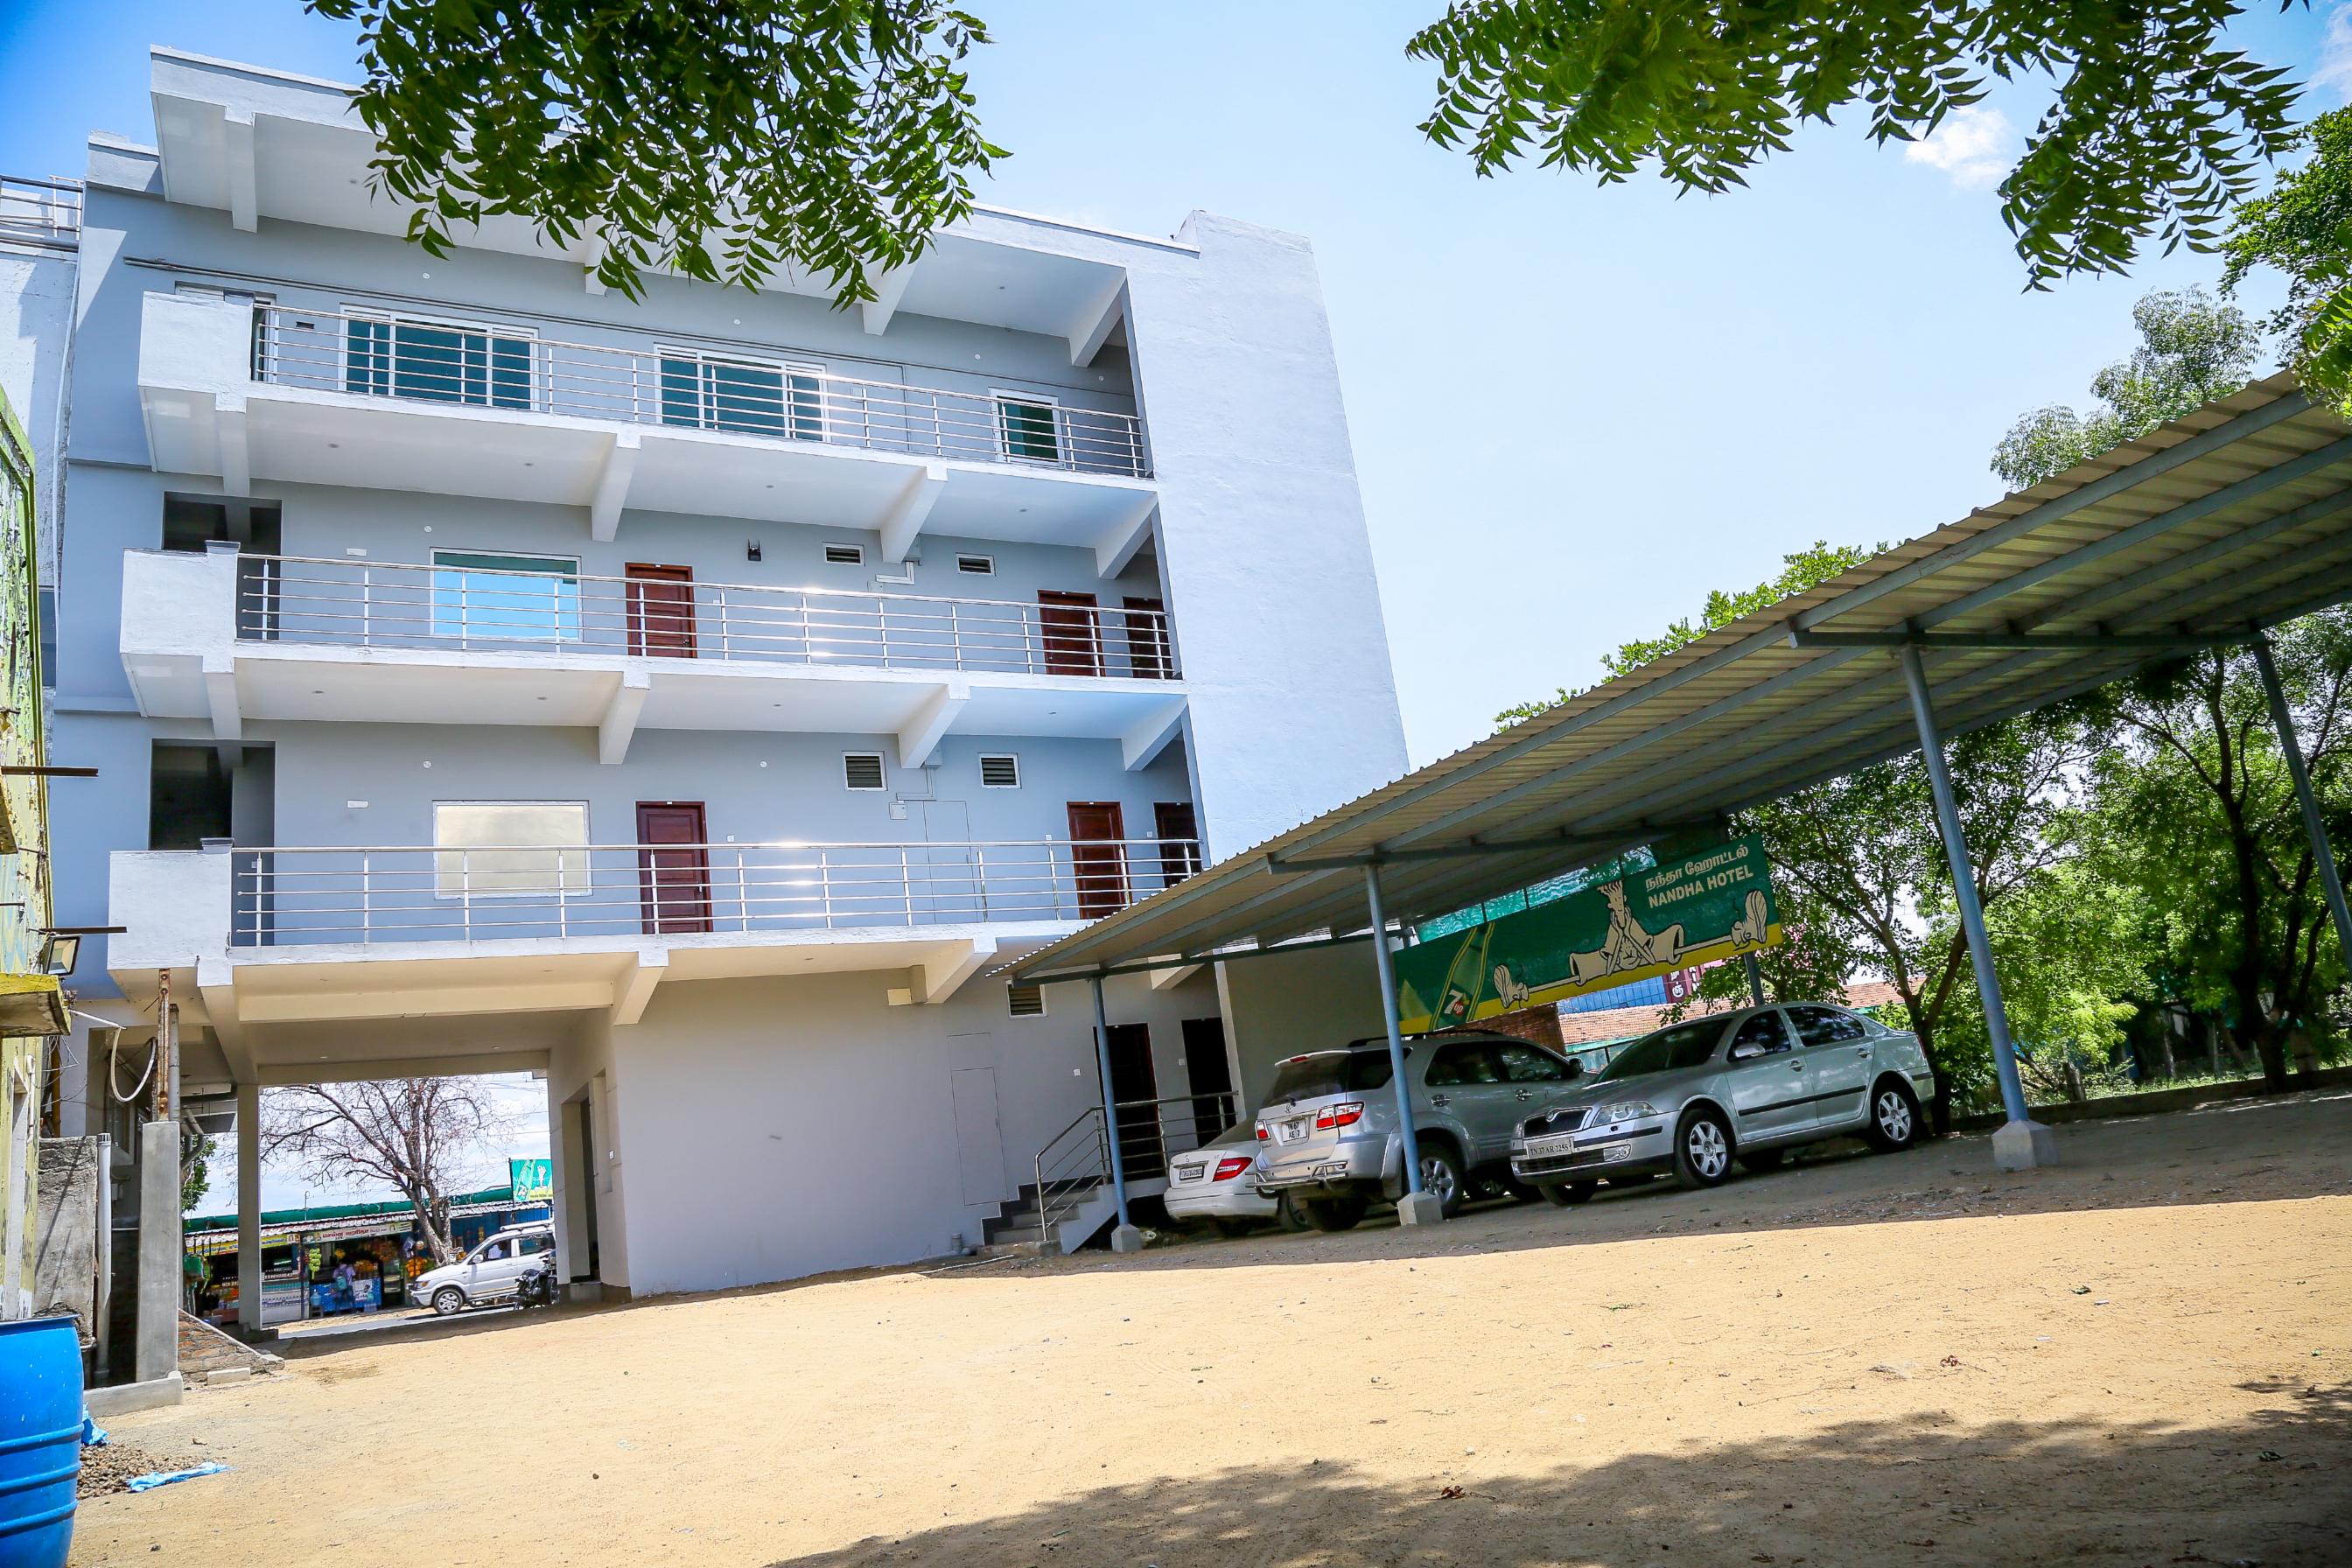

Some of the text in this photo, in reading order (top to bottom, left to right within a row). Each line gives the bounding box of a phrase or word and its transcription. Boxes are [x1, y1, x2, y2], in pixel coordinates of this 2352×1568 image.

[1645, 844, 1749, 892] நந்தா ஹோட்டல்
[1648, 864, 1754, 908] NANDHA HOTEL
